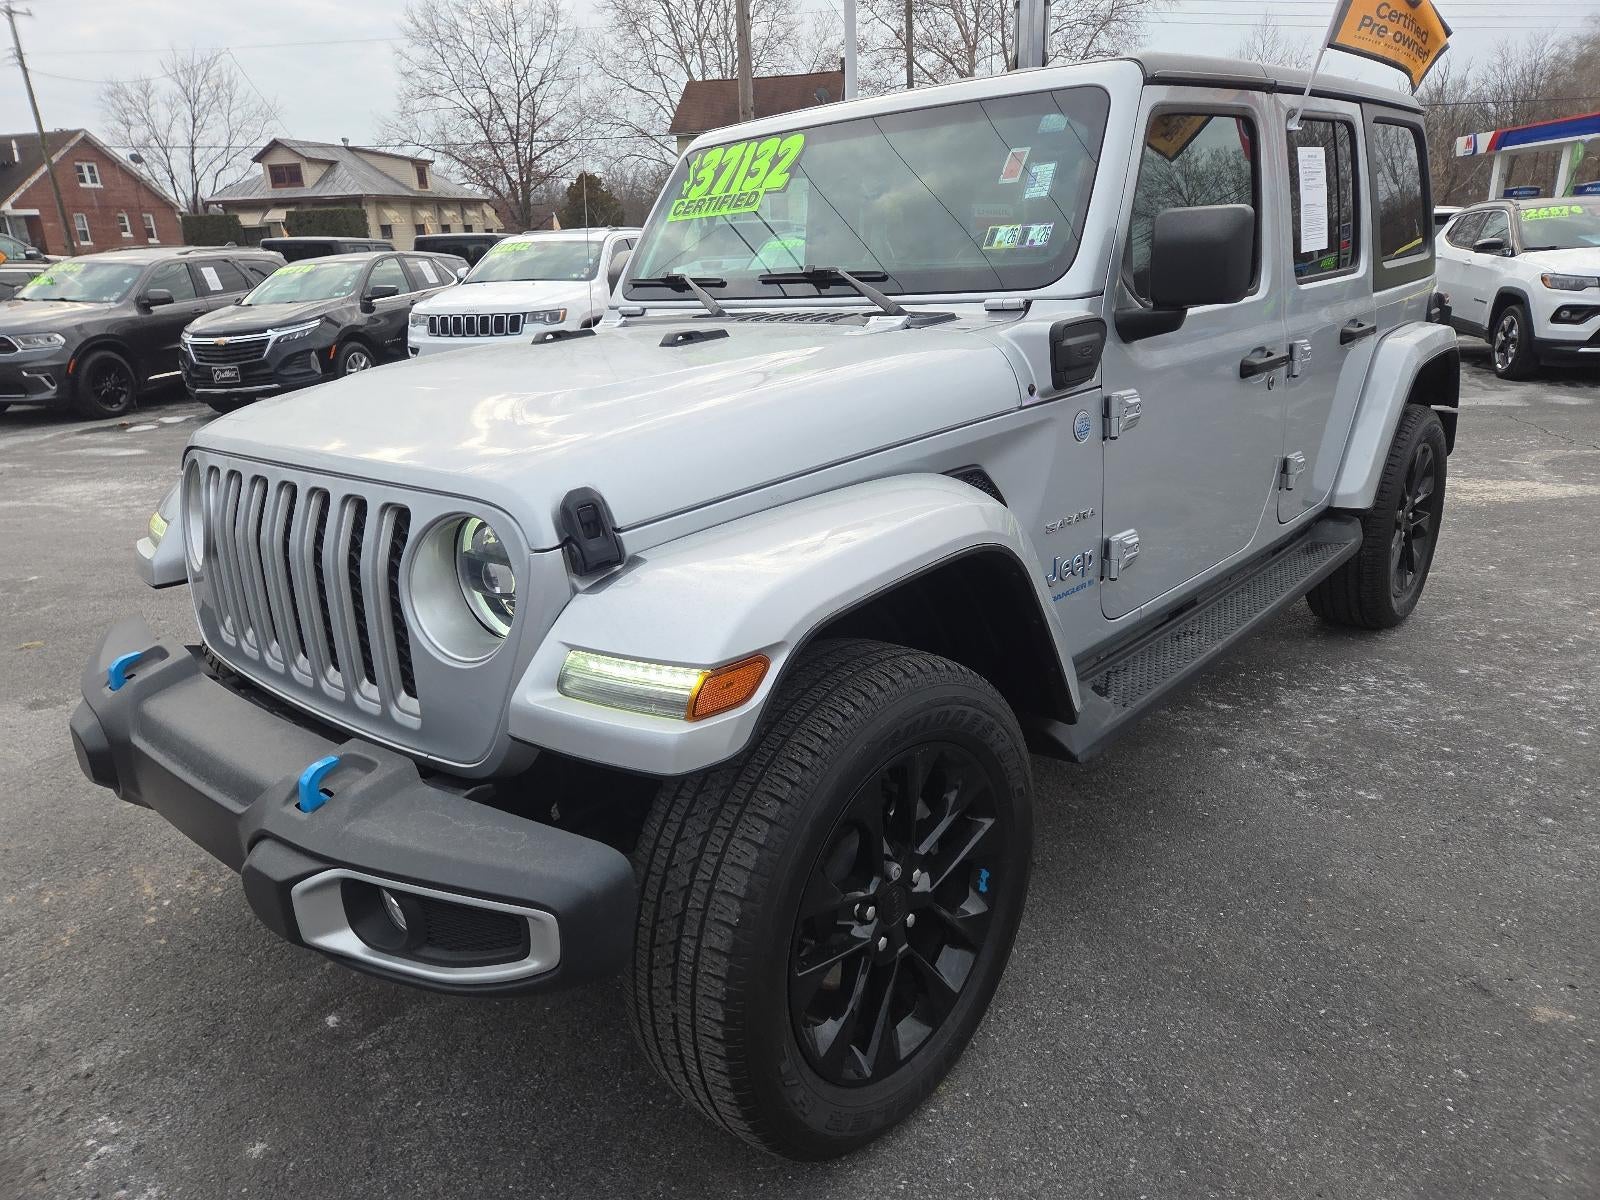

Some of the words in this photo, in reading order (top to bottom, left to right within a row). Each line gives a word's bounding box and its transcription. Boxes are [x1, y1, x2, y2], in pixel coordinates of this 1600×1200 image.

[1376, 2, 1429, 45] Certified
[683, 133, 805, 199] $37132
[672, 190, 761, 217] CERTIFIED
[1045, 507, 1096, 535] SAHARA
[1045, 549, 1094, 588] Jeep
